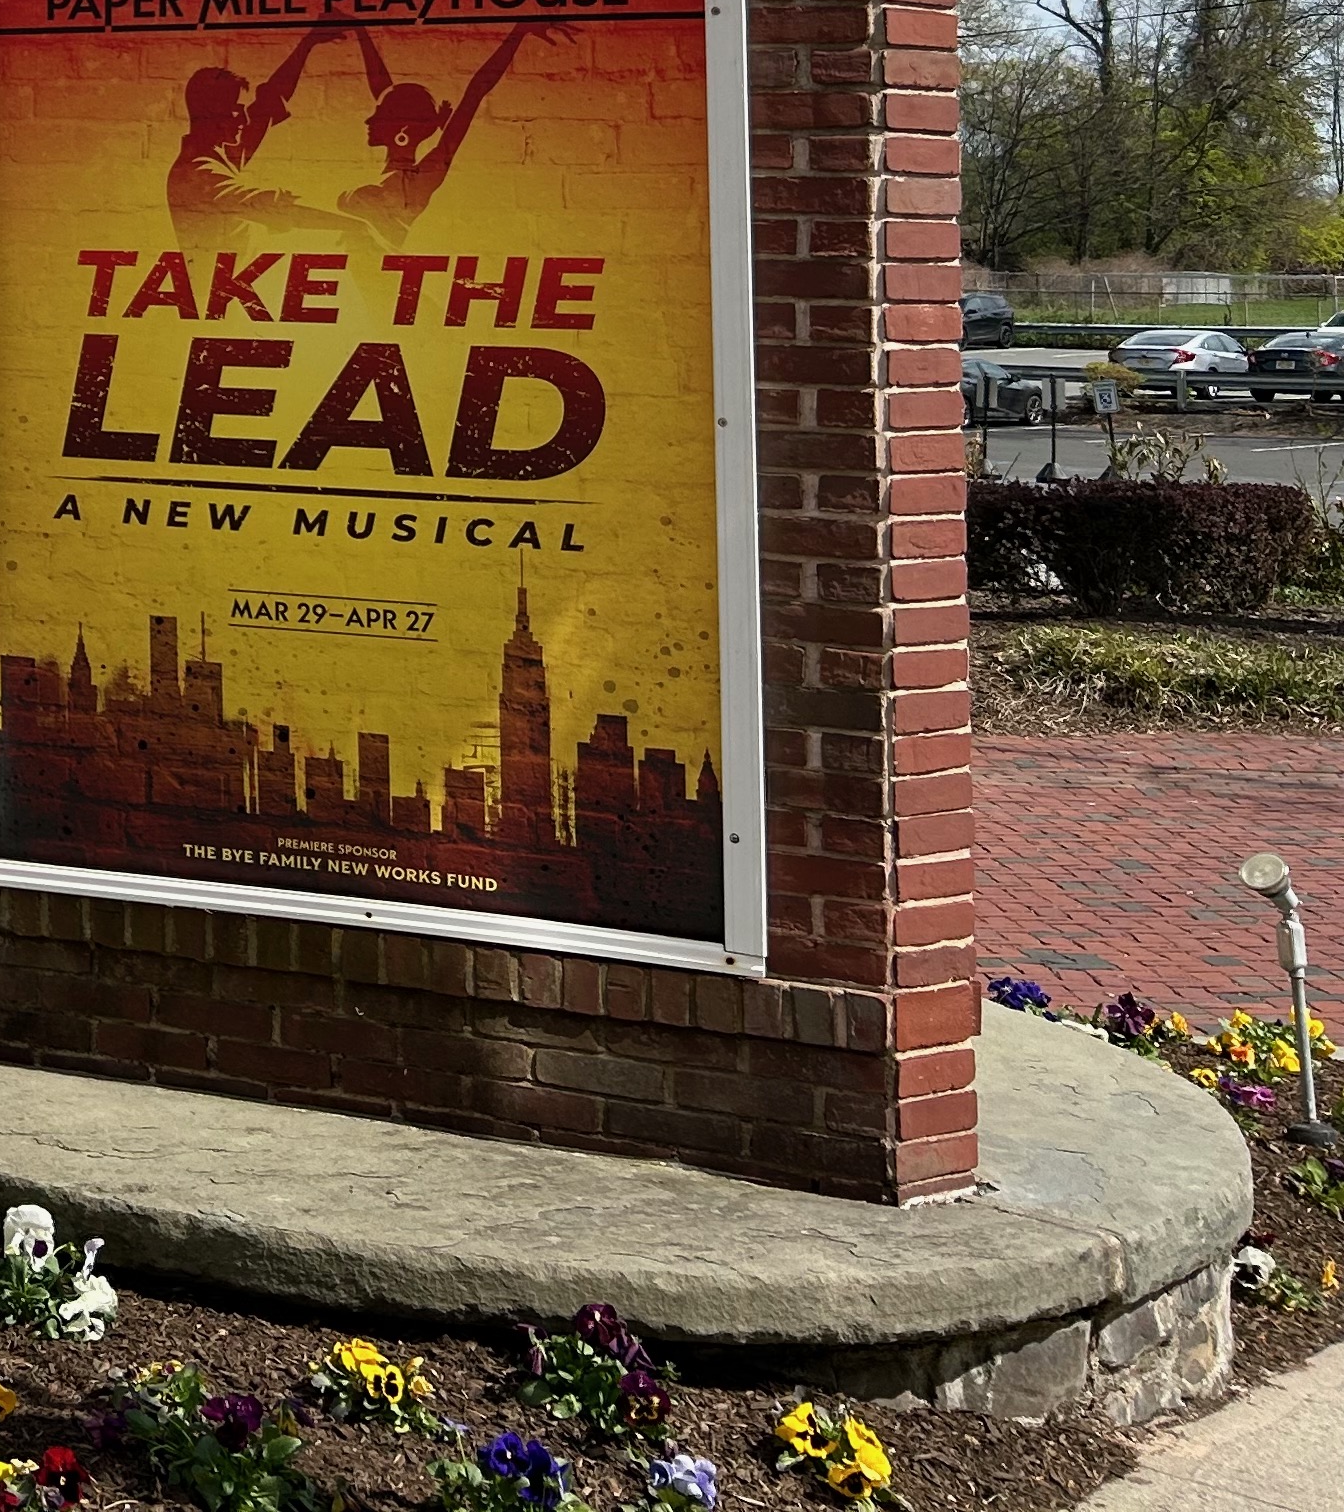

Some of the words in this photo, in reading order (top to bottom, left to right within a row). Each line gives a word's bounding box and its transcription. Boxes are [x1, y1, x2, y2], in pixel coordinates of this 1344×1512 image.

[76, 249, 348, 324] TAKE
[381, 254, 606, 330] THE
[61, 333, 607, 482] LEAD
[53, 493, 82, 521] A
[122, 497, 252, 532] NEW
[292, 507, 587, 553] MUSICAL
[230, 598, 289, 622] MAR
[405, 610, 435, 633] 27
[183, 843, 217, 860] THE
[222, 847, 254, 864] BYE
[259, 851, 322, 871] FAMILY
[327, 859, 369, 876] NEW
[374, 864, 442, 886] WORKS
[446, 872, 498, 892] FUND
[277, 837, 335, 854] PREMIERE
[338, 843, 397, 861] SPONSOR
